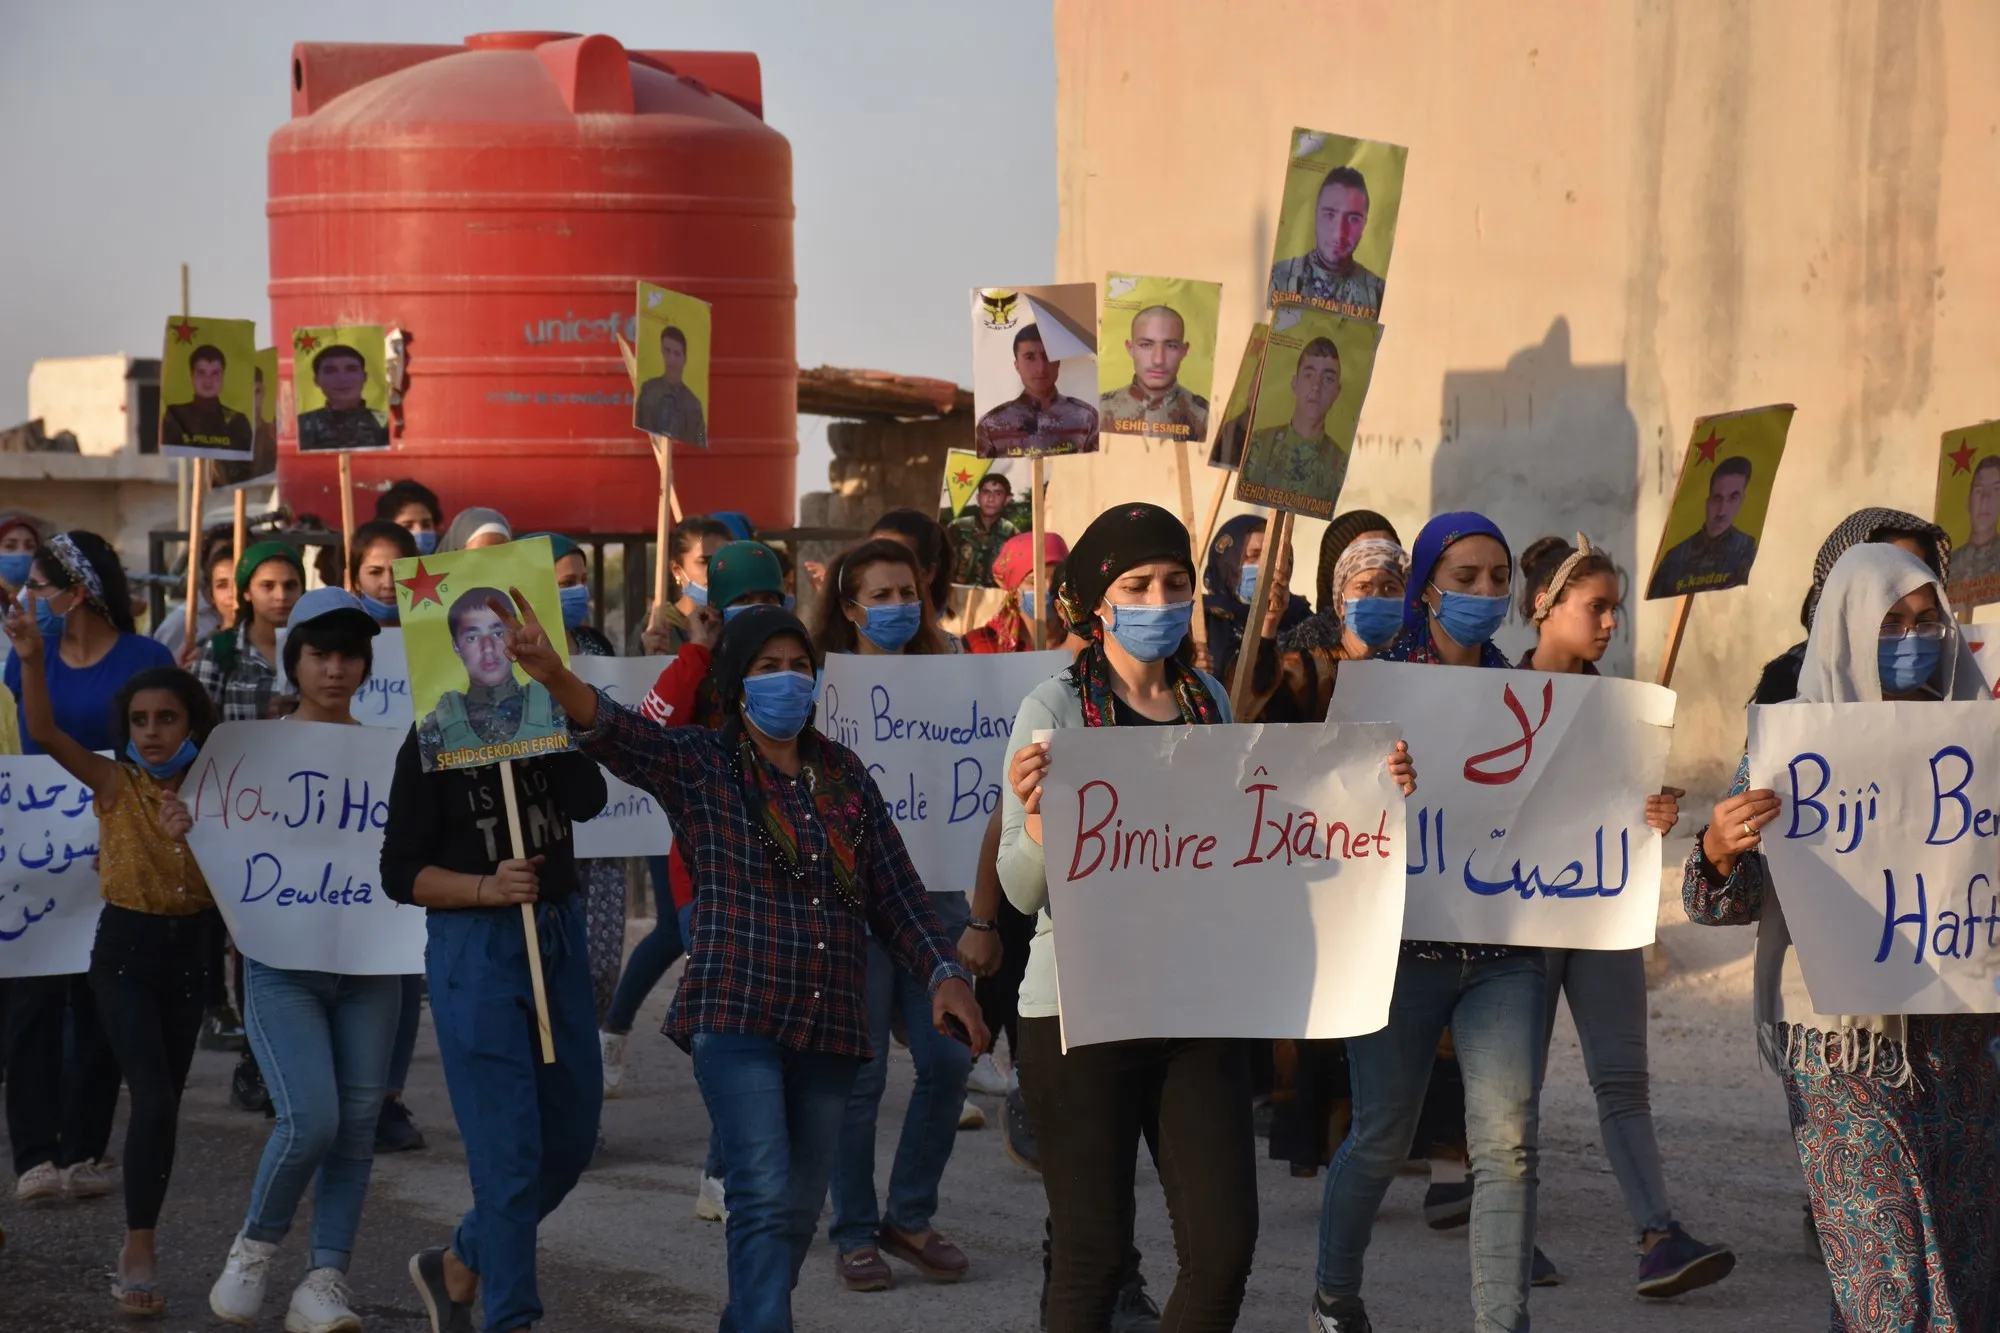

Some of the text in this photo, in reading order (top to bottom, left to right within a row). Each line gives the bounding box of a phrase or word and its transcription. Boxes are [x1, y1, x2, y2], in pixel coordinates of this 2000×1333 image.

[1152, 422, 1190, 436] ESMER
[1463, 678, 1553, 786] لا
[1067, 780, 1218, 882] Bimire
[1784, 752, 1881, 853] Bijî
